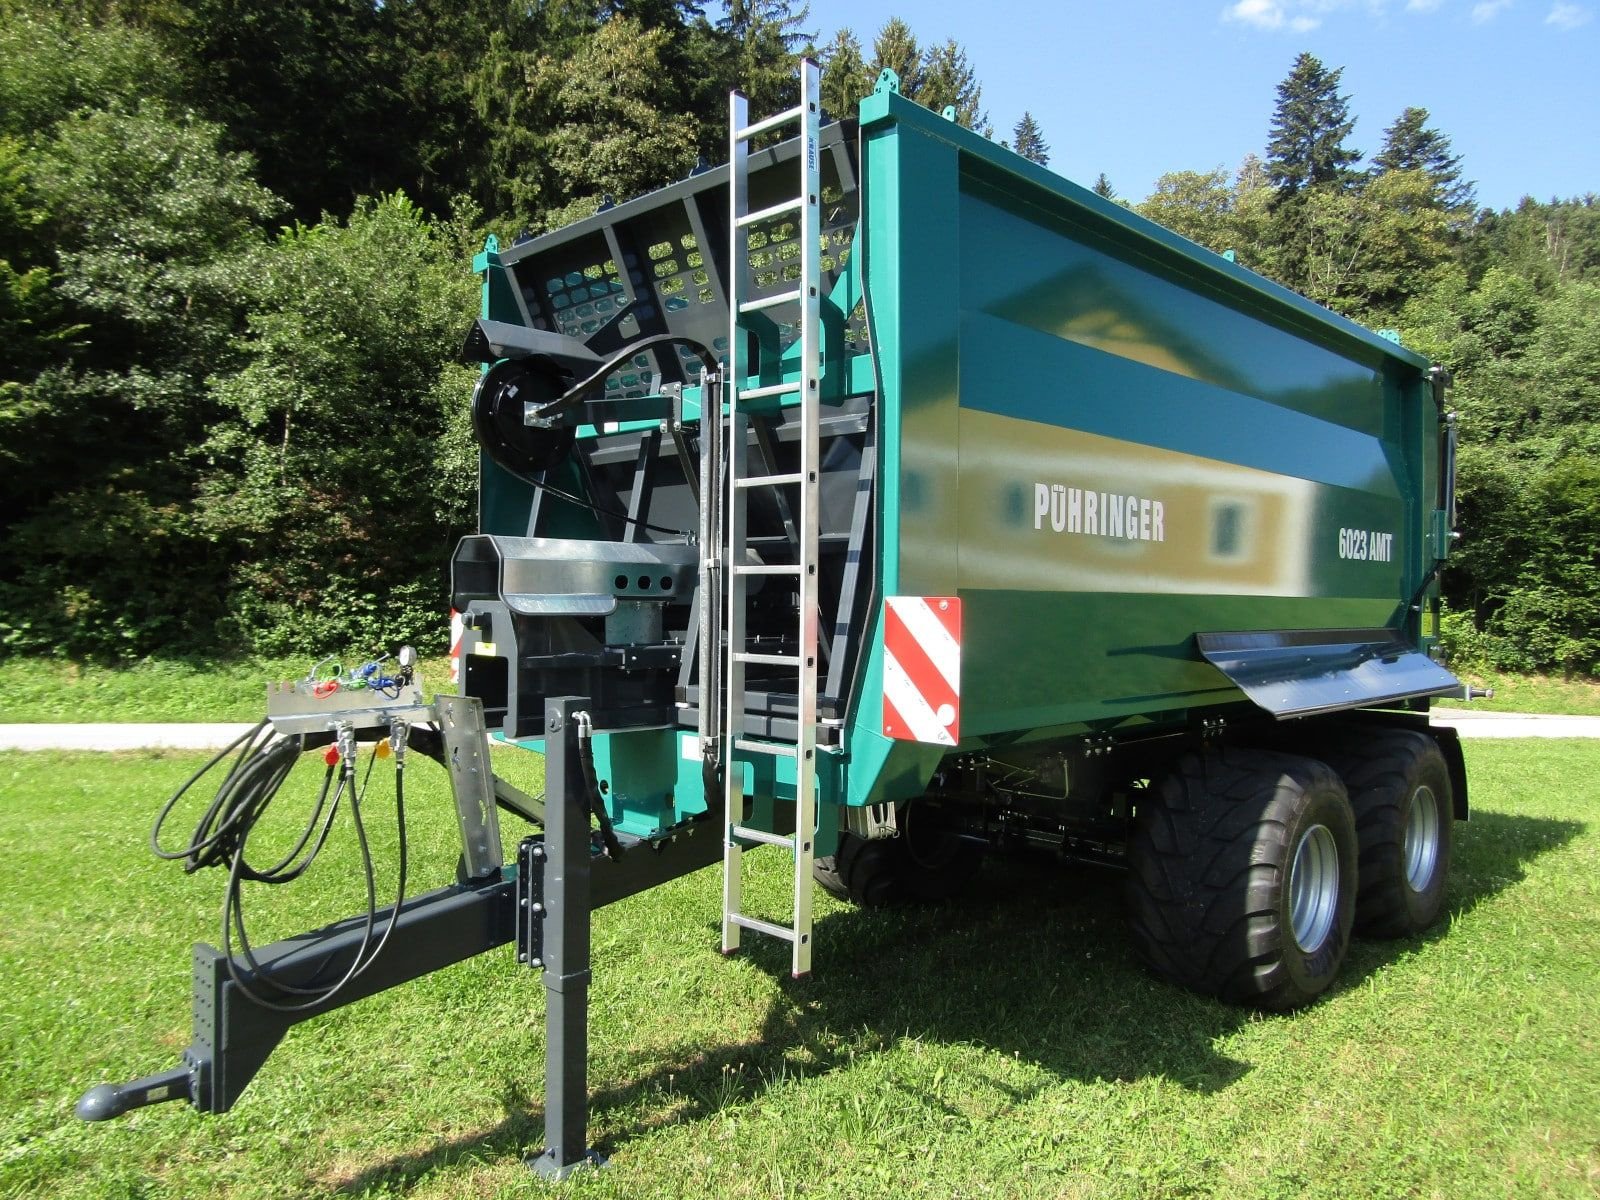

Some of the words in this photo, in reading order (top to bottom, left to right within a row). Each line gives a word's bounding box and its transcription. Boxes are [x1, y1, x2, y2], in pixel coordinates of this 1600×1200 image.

[1034, 483, 1164, 542] PÜHRINGER
[1339, 527, 1367, 561] 6023
[1369, 531, 1392, 562] AMT
